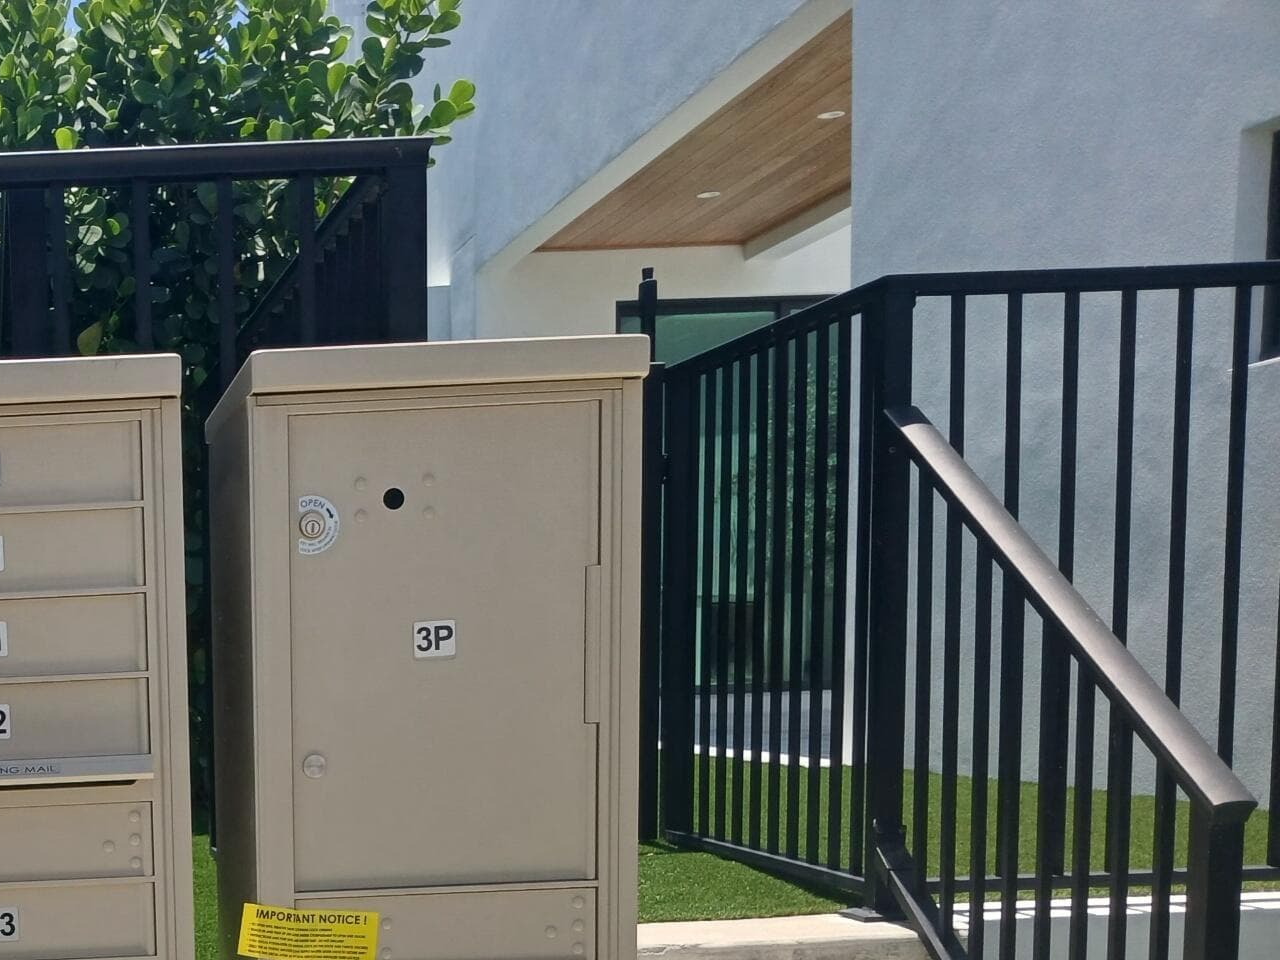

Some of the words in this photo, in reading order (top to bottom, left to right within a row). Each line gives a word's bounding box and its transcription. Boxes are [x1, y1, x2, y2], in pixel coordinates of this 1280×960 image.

[300, 498, 326, 509] OPEN
[416, 625, 454, 652] 3P
[24, 765, 54, 774] MAIL
[255, 909, 316, 924] IMPORTANT
[318, 914, 361, 925] NOTICE
